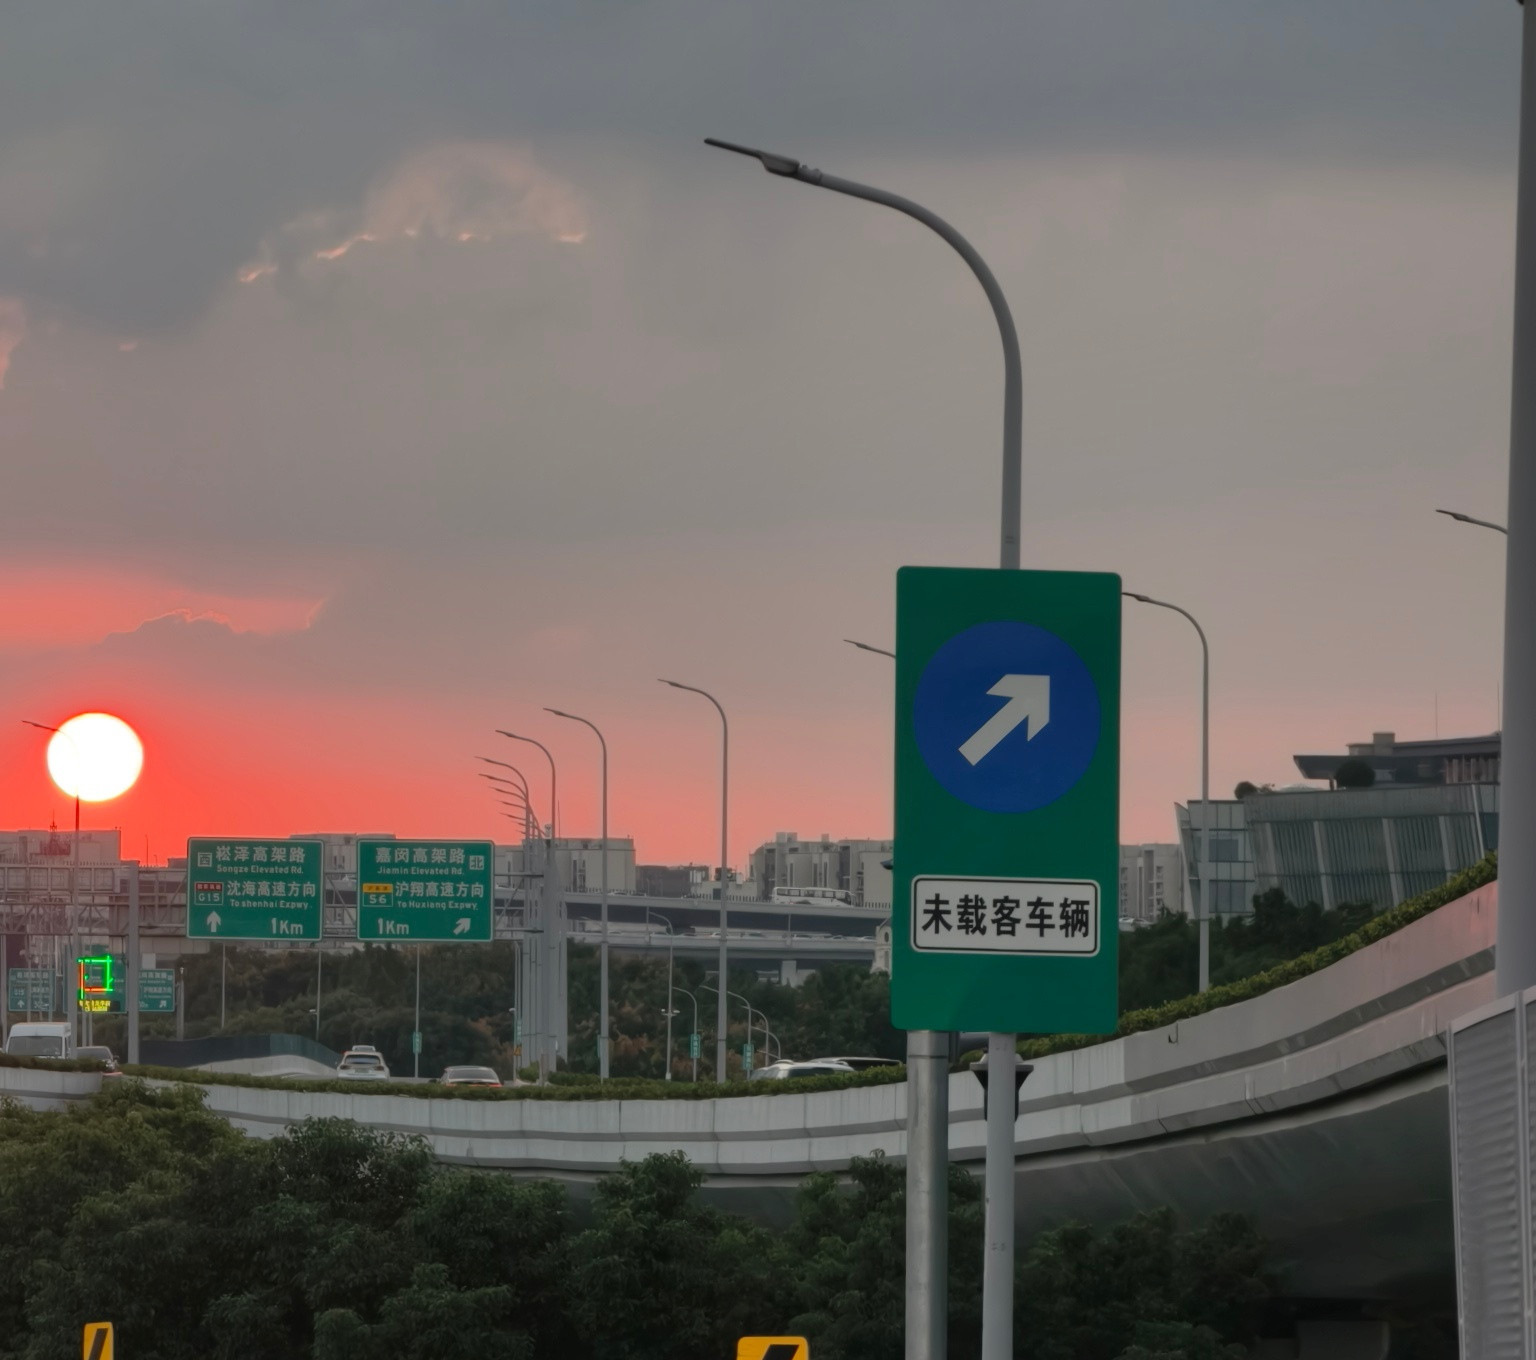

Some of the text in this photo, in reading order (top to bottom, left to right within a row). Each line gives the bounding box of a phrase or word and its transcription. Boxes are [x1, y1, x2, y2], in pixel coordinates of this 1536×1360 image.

[251, 865, 289, 874] Elevated
[227, 881, 316, 897] 沈海高速方向
[396, 882, 484, 898] 沪翔高速方向
[199, 893, 220, 902] G15
[369, 895, 387, 904] S6
[922, 893, 1090, 938] 未载客车辆
[271, 917, 304, 934] 1Km
[378, 917, 409, 935] 1Km
